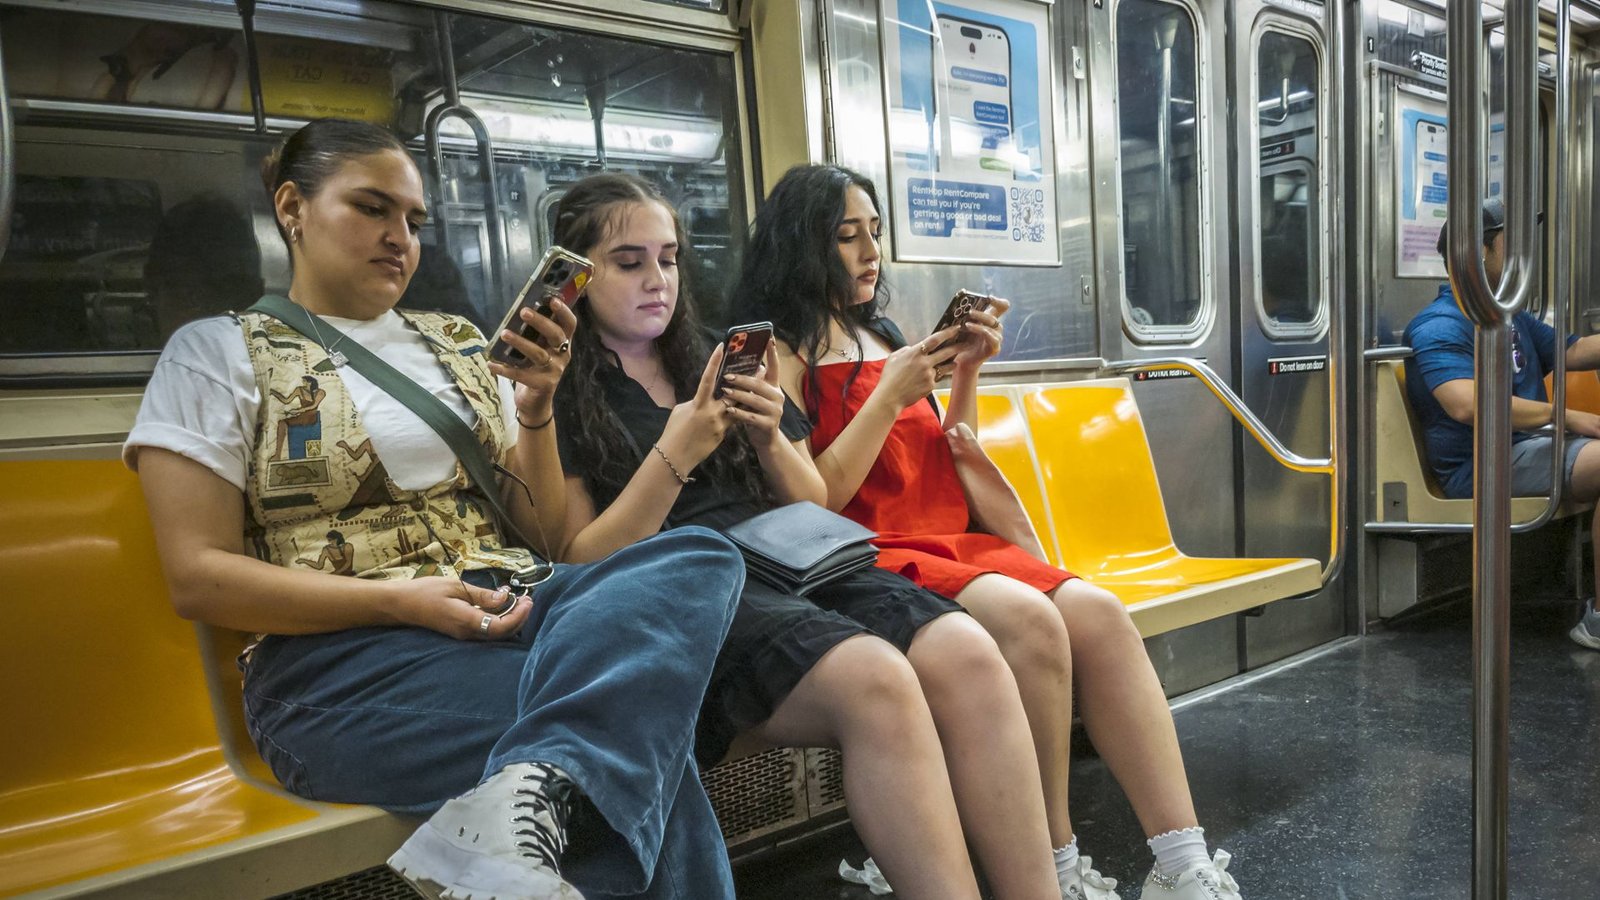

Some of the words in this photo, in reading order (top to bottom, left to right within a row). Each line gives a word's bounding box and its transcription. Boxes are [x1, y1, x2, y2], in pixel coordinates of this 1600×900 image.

[1369, 39, 1373, 51] 1
[1421, 55, 1436, 69] Priority
[1435, 60, 1447, 74] Seatin
[912, 185, 942, 197] RentHop
[943, 188, 990, 200] RentCompare
[913, 198, 926, 206] can
[926, 198, 938, 207] tell
[938, 200, 952, 208] you
[952, 200, 958, 208] if
[959, 202, 981, 210] you're
[913, 210, 940, 219] getting
[946, 212, 964, 221] good
[973, 213, 987, 221] bad
[987, 214, 1002, 222] deal
[1279, 362, 1287, 372] Do
[1287, 362, 1296, 371] not
[1296, 361, 1307, 371] lean
[1307, 362, 1313, 370] on
[1313, 360, 1324, 370] door
